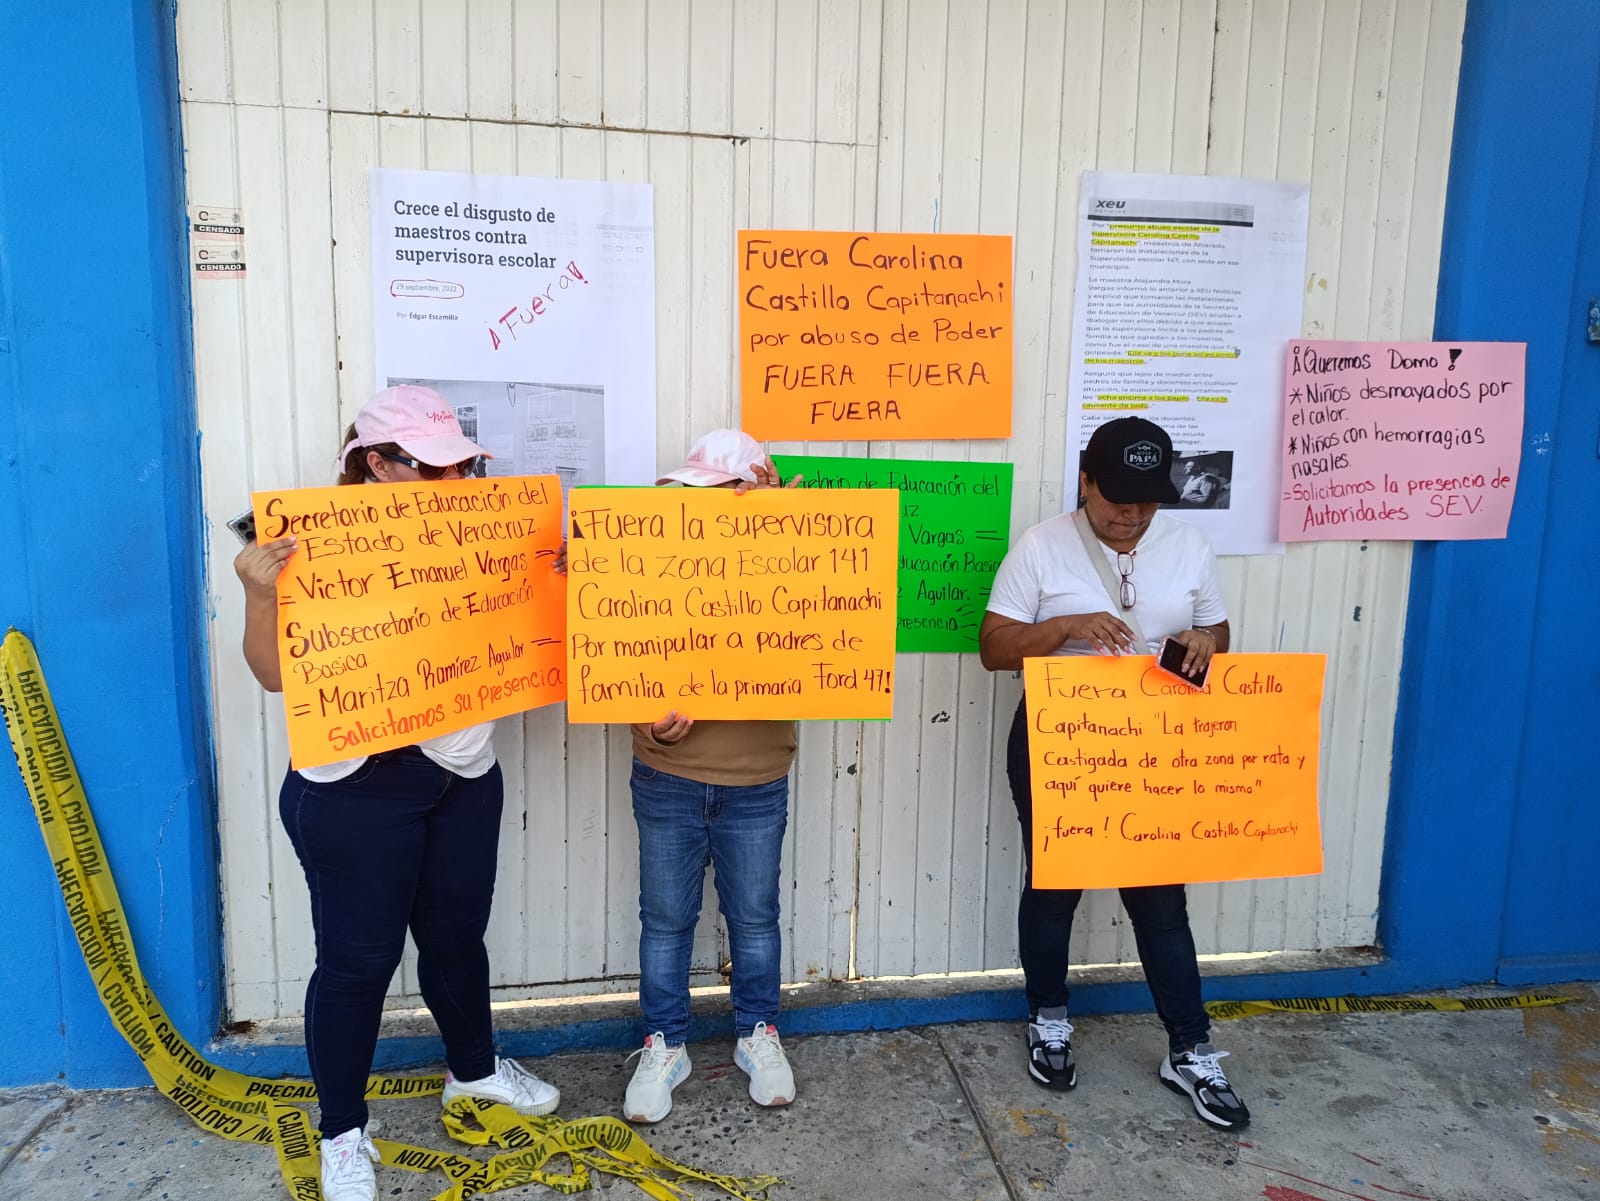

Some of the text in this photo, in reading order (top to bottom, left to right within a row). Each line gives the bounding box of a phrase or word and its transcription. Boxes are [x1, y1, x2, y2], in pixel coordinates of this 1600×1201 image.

[394, 200, 555, 224] Crece el disgusto de
[1096, 200, 1126, 208] xeu
[394, 225, 527, 244] maestros contra
[395, 248, 556, 268] supervisora escolar
[745, 236, 963, 271] Fuera Carolina
[405, 284, 440, 292] septiembre,
[745, 279, 1004, 314] Castillo Capitanachi
[429, 313, 459, 321] Escamilla
[750, 318, 1003, 352] por abuso de Poder
[764, 362, 990, 394] FUERA FUERA
[1360, 378, 1471, 402] desmayados
[1479, 381, 1512, 403] por
[810, 400, 901, 425] FUERA
[1292, 409, 1304, 426] el
[1343, 427, 1367, 444] con
[1374, 421, 1485, 450] hemorragias
[973, 474, 999, 497] del
[1385, 474, 1399, 493] la
[1407, 469, 1485, 496] presencia
[1491, 467, 1511, 488] de
[264, 482, 549, 539] Secretario de Educación del
[681, 502, 704, 540] la
[716, 513, 875, 539] supervisora
[1302, 499, 1409, 532] Autoridades
[300, 534, 404, 562] Estado
[418, 520, 443, 547] de
[908, 524, 965, 548] Vargas
[296, 550, 528, 600] Victor Emanuel Vargas
[571, 547, 609, 574] de
[620, 547, 646, 577] la
[737, 547, 820, 576] Escolar
[830, 547, 869, 574] 141
[899, 554, 959, 573] ducación
[441, 598, 462, 623] de
[462, 578, 534, 617] Educación
[578, 582, 882, 620] Carolina Castillo Capitanachi
[614, 628, 717, 661] manipular
[727, 631, 743, 649] a
[757, 630, 824, 654] padres
[832, 630, 864, 651] de
[318, 673, 410, 717] Maritza
[453, 692, 472, 714] su
[478, 666, 563, 710] presencia
[581, 662, 892, 704] familia de la primaria Ford 47!
[1044, 662, 1126, 700] Fuera
[1223, 664, 1283, 696] Castillo
[1036, 708, 1143, 740] Capitanachi
[1193, 716, 1238, 738] trajeron
[1138, 752, 1158, 768] de
[1172, 748, 1198, 768] otra
[1205, 754, 1234, 766] zona
[1242, 754, 1258, 770] por
[1263, 745, 1290, 765] rata
[1296, 754, 1306, 770] y
[1044, 776, 1262, 802] aquí quiere hacer lo mismo"
[1120, 812, 1181, 842] Carolina
[1191, 820, 1240, 840] Castillo
[1242, 819, 1298, 842] Capitanachi
[155, 1022, 216, 1081] CAUTION
[245, 1082, 317, 1098] PRECAU
[168, 1086, 243, 1134] CAUTION
[277, 1110, 311, 1160] CAUTION
